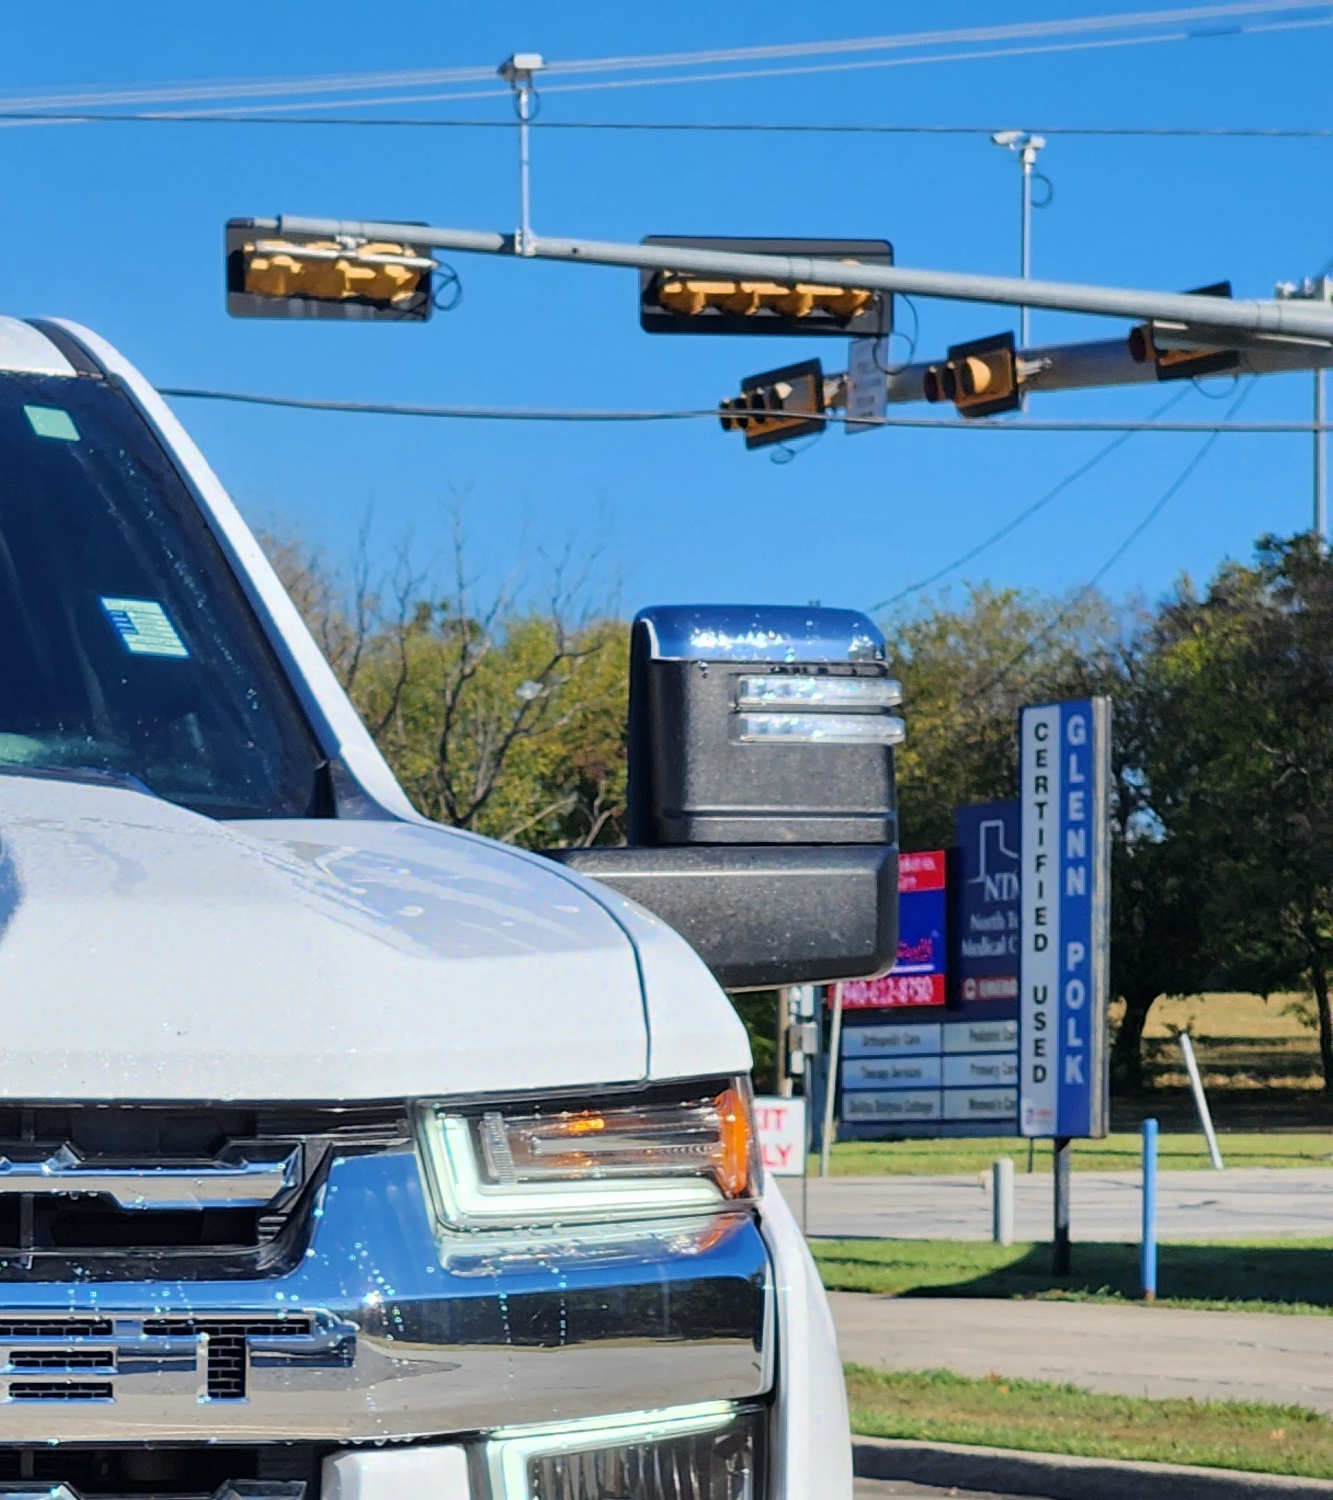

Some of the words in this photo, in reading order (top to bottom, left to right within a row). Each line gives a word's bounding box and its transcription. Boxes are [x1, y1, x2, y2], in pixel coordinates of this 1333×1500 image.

[1033, 722, 1050, 953] CERTIFIED
[1066, 714, 1087, 896] GLENN
[1032, 985, 1048, 1084] USED
[1065, 942, 1085, 1084] POLK
[762, 1144, 793, 1166] LY
